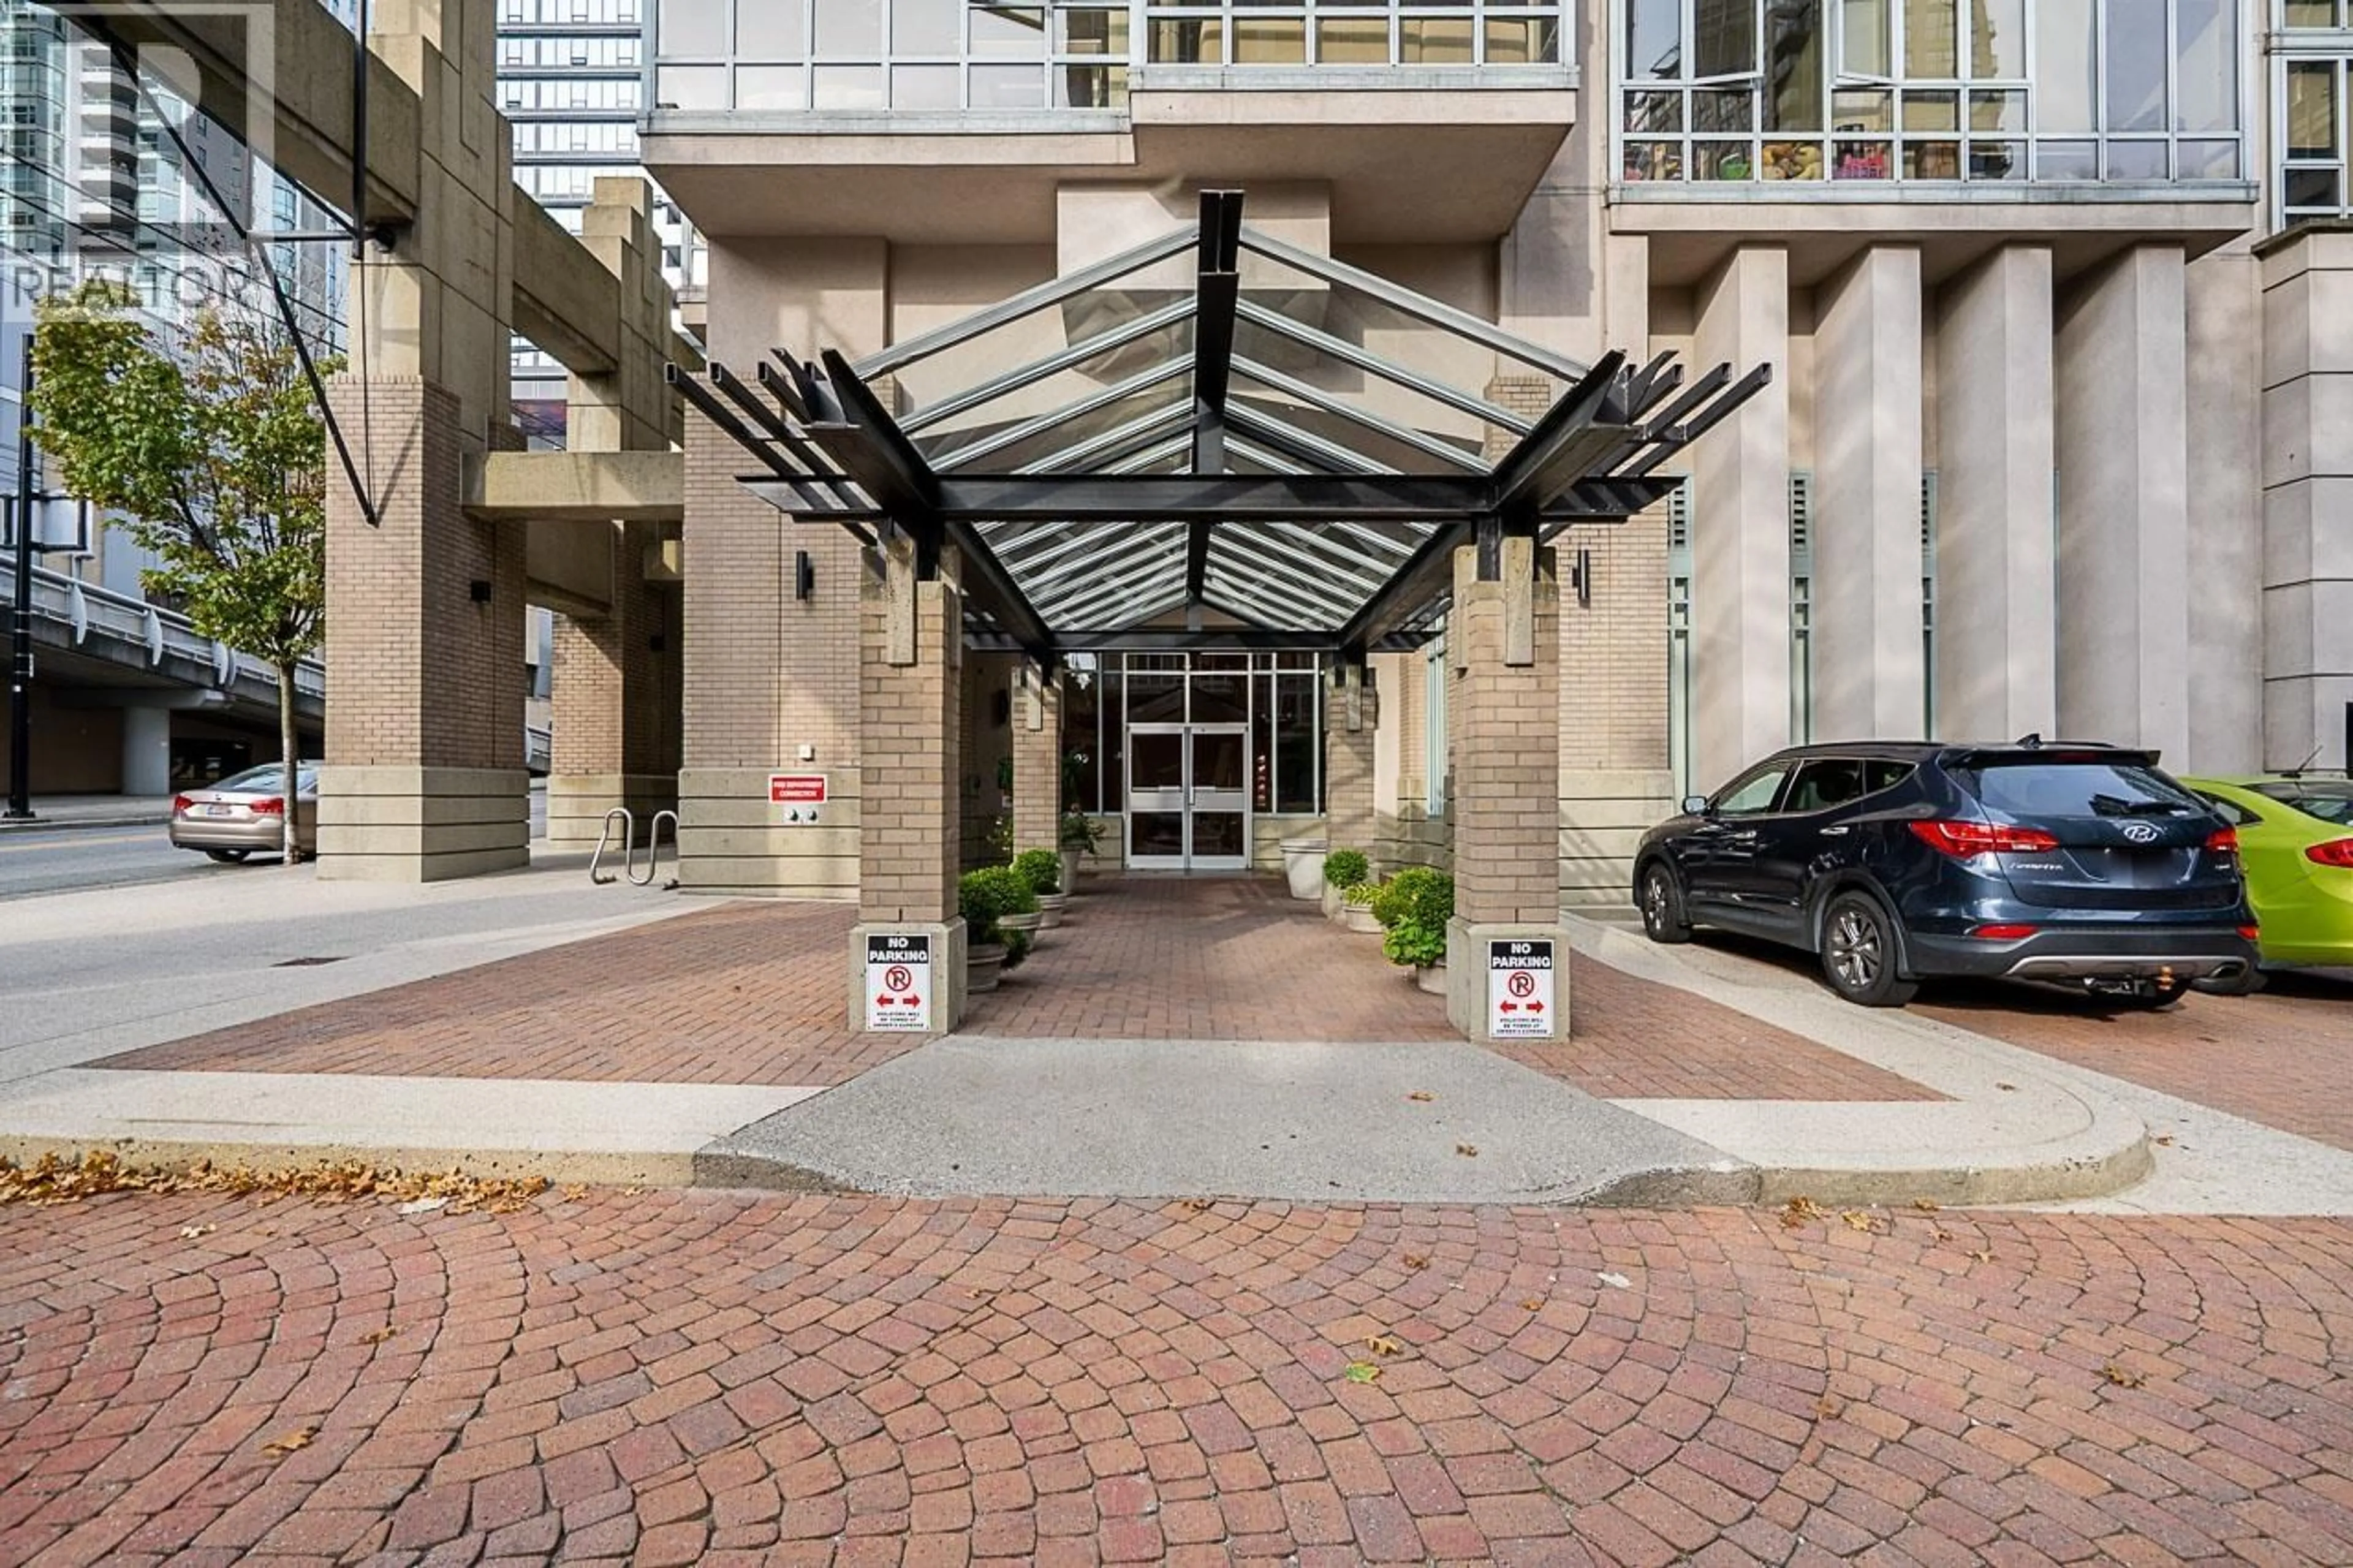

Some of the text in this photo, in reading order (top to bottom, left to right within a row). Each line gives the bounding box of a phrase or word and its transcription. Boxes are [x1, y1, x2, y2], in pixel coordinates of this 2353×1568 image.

[887, 937, 909, 948] NO
[1510, 943, 1532, 954] NO
[870, 950, 928, 961] PARKING
[1492, 956, 1551, 968] PARKING
